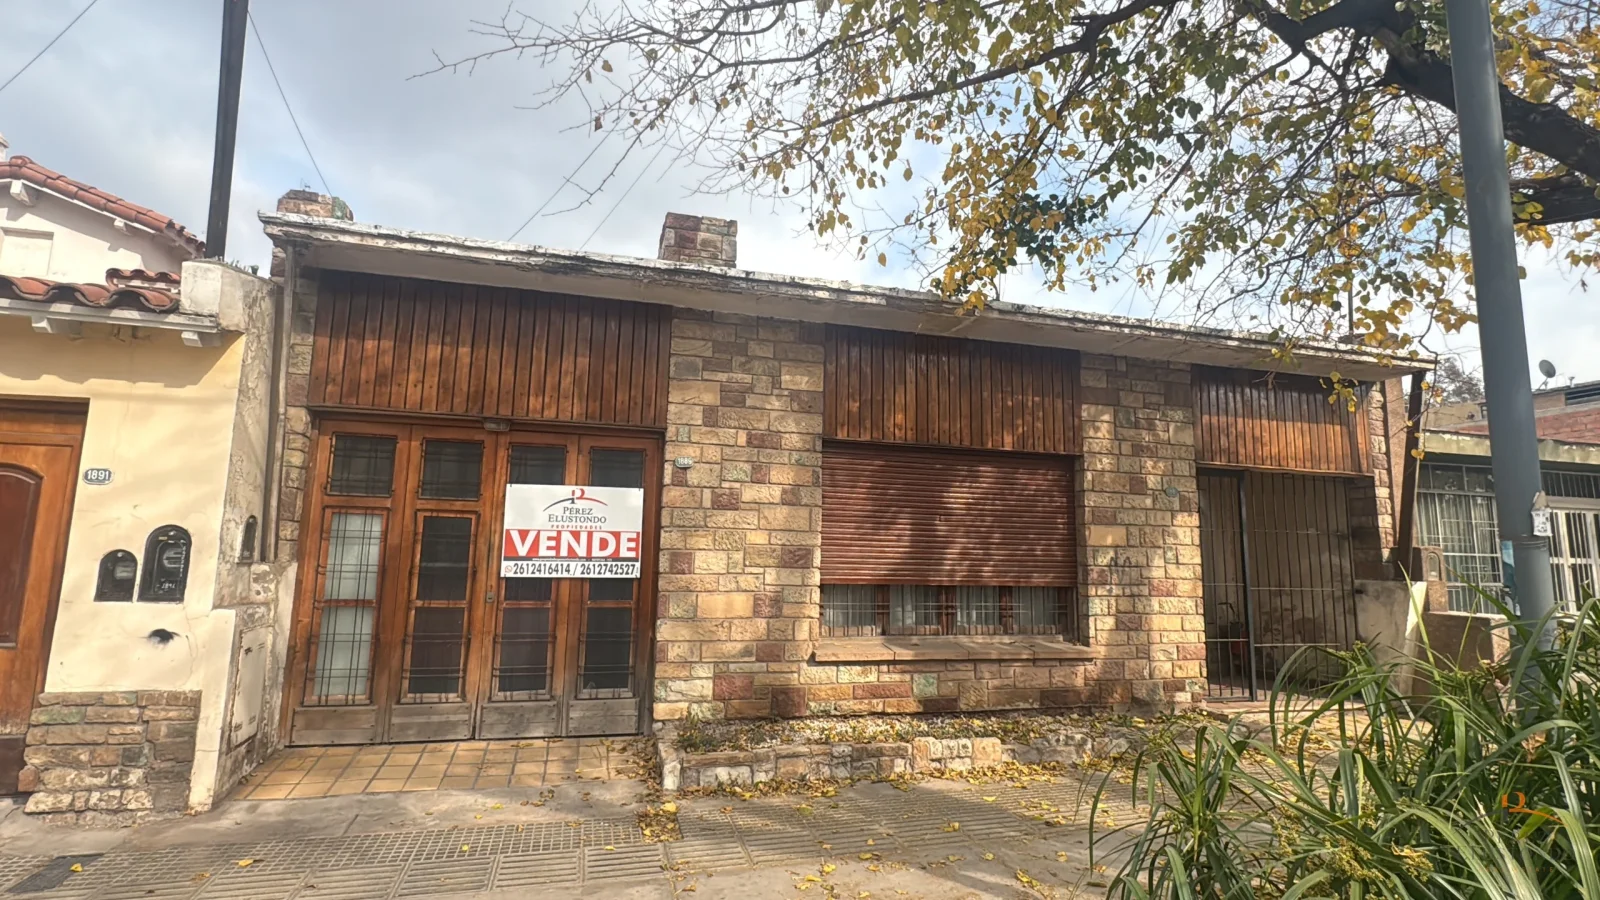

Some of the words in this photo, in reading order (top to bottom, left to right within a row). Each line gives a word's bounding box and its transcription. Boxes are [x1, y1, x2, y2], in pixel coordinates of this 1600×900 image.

[87, 469, 109, 480] 1891
[563, 506, 593, 515] PÉREZ
[547, 513, 607, 524] ELUSTONDO
[509, 530, 637, 558] VENDE
[513, 562, 571, 575] 2612416414
[580, 563, 636, 576] 2612742527
